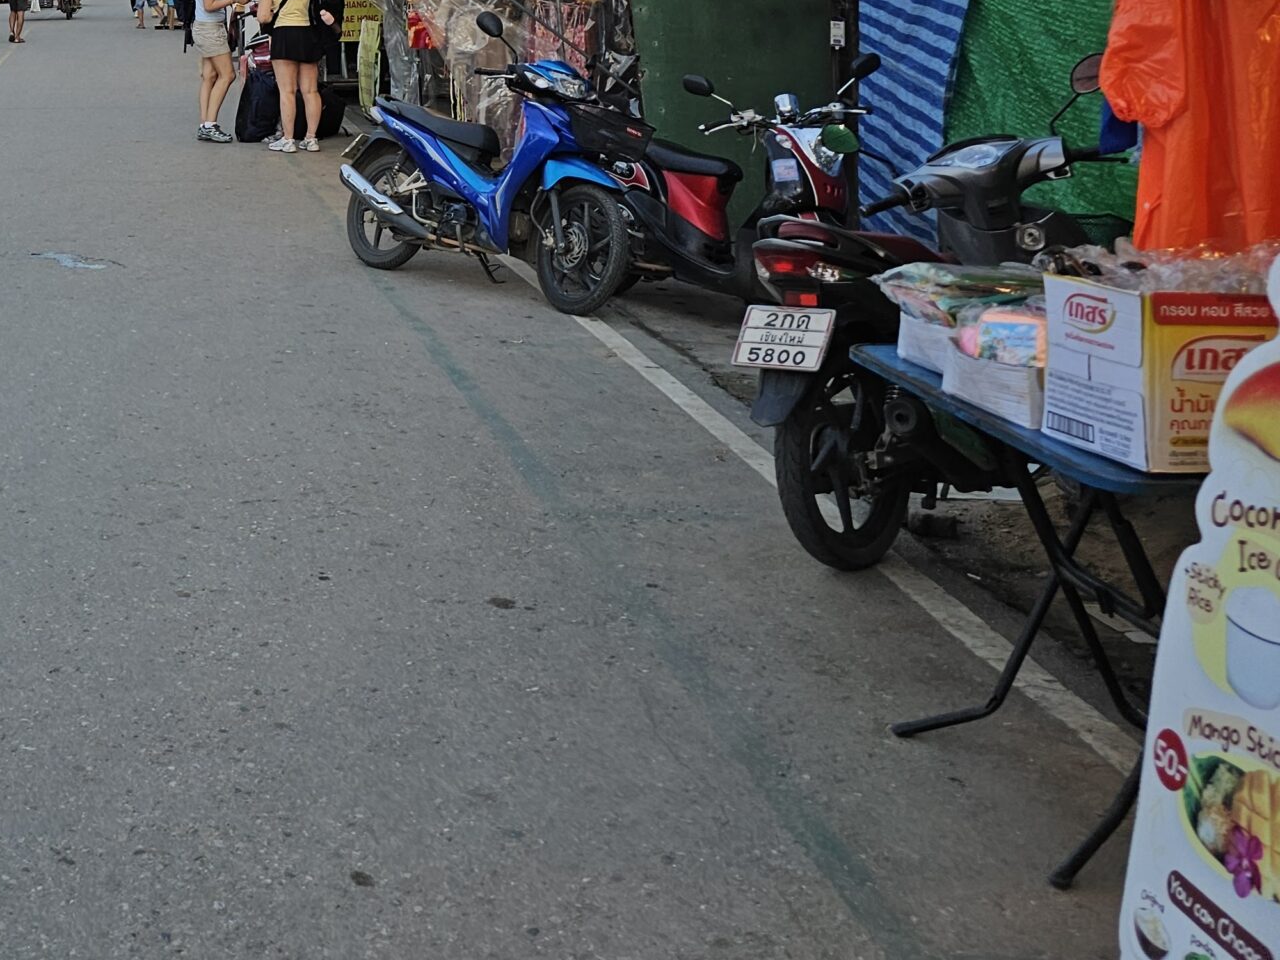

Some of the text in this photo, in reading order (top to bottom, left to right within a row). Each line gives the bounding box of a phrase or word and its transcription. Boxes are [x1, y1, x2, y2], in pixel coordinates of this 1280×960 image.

[343, 1, 368, 9] HIANG
[1160, 305, 1197, 317] กรอบ
[1201, 305, 1230, 317] หอม
[760, 331, 805, 344] เชียงใหม่
[747, 347, 806, 365] 5800
[1185, 346, 1249, 371] เกส
[1237, 540, 1271, 572] Ice
[1188, 715, 1241, 752] Mango
[1169, 874, 1193, 908] You
[1192, 902, 1216, 930] can
